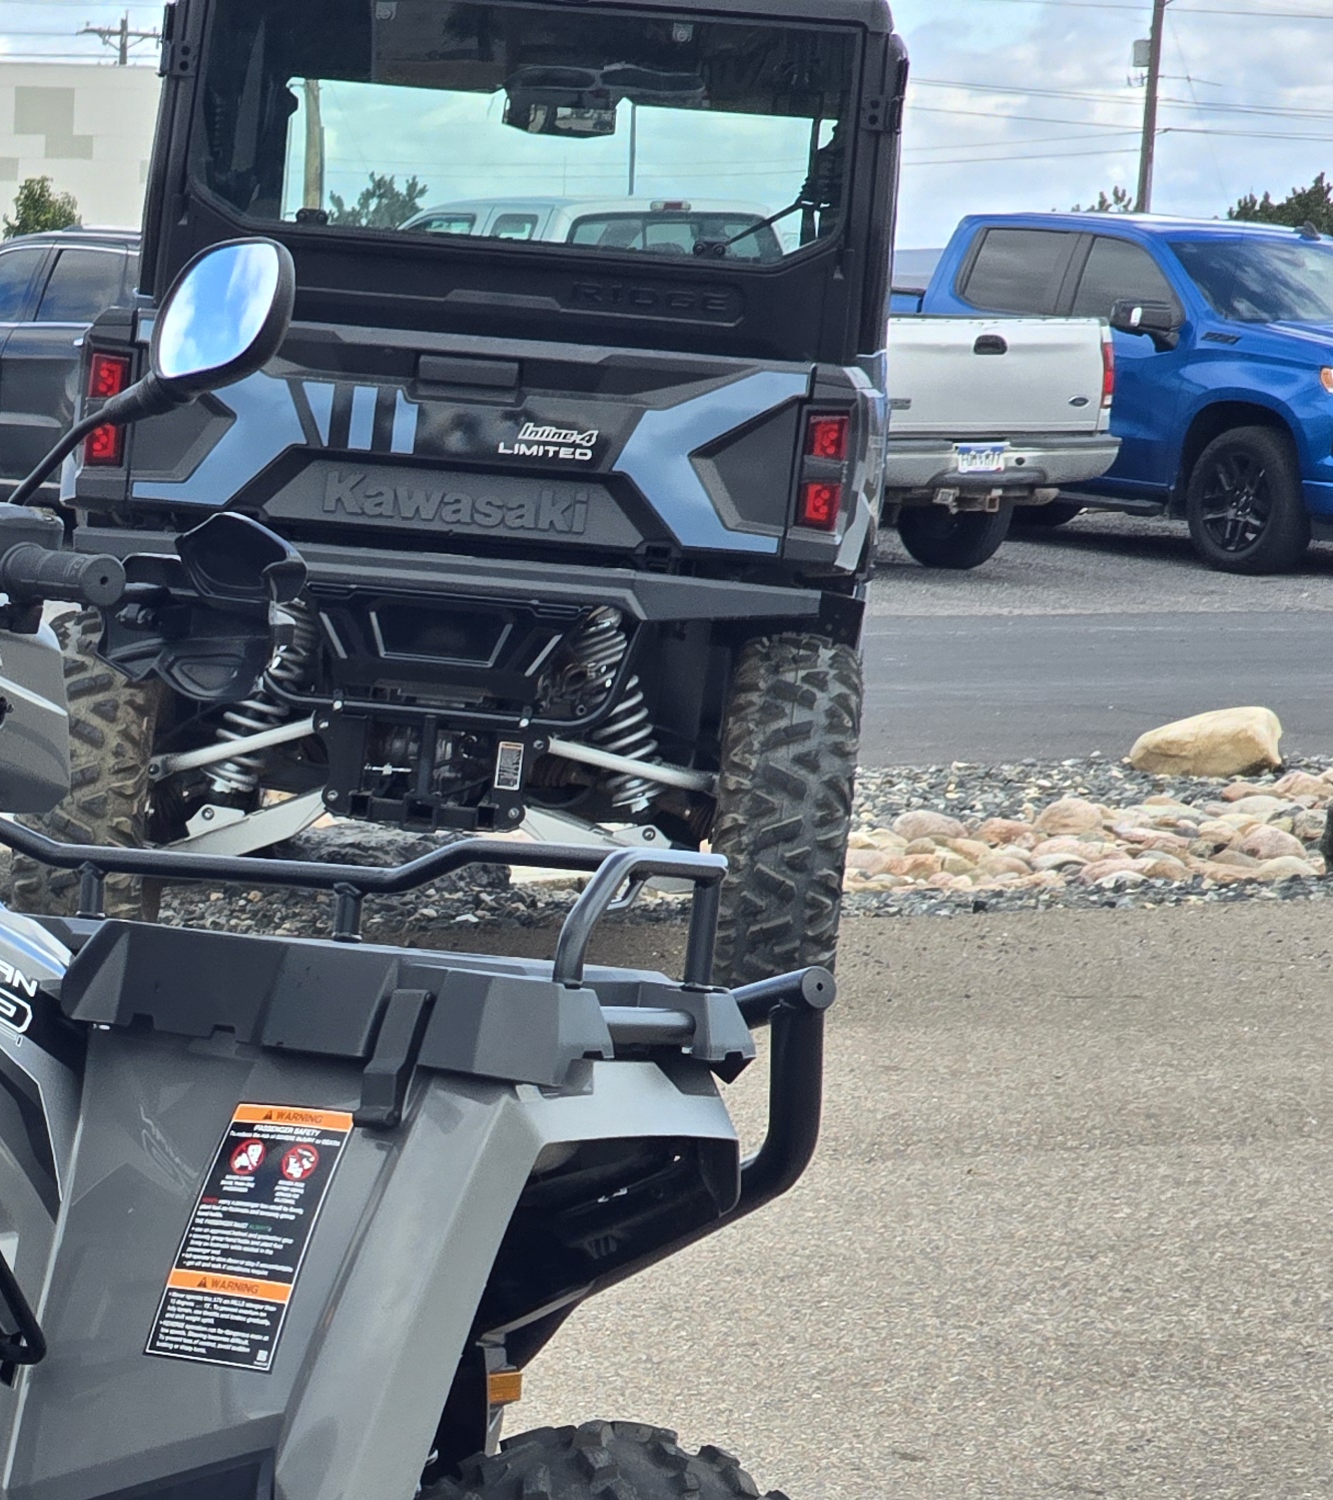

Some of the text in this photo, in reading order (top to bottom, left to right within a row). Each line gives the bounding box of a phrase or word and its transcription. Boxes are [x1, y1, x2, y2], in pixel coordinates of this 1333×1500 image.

[572, 281, 729, 311] RIDGE
[518, 422, 599, 446] Inline-4
[498, 442, 593, 461] LIMITED
[321, 469, 590, 535] Kawasaki
[276, 1111, 324, 1125] WARNING
[211, 1278, 259, 1295] WARNING
